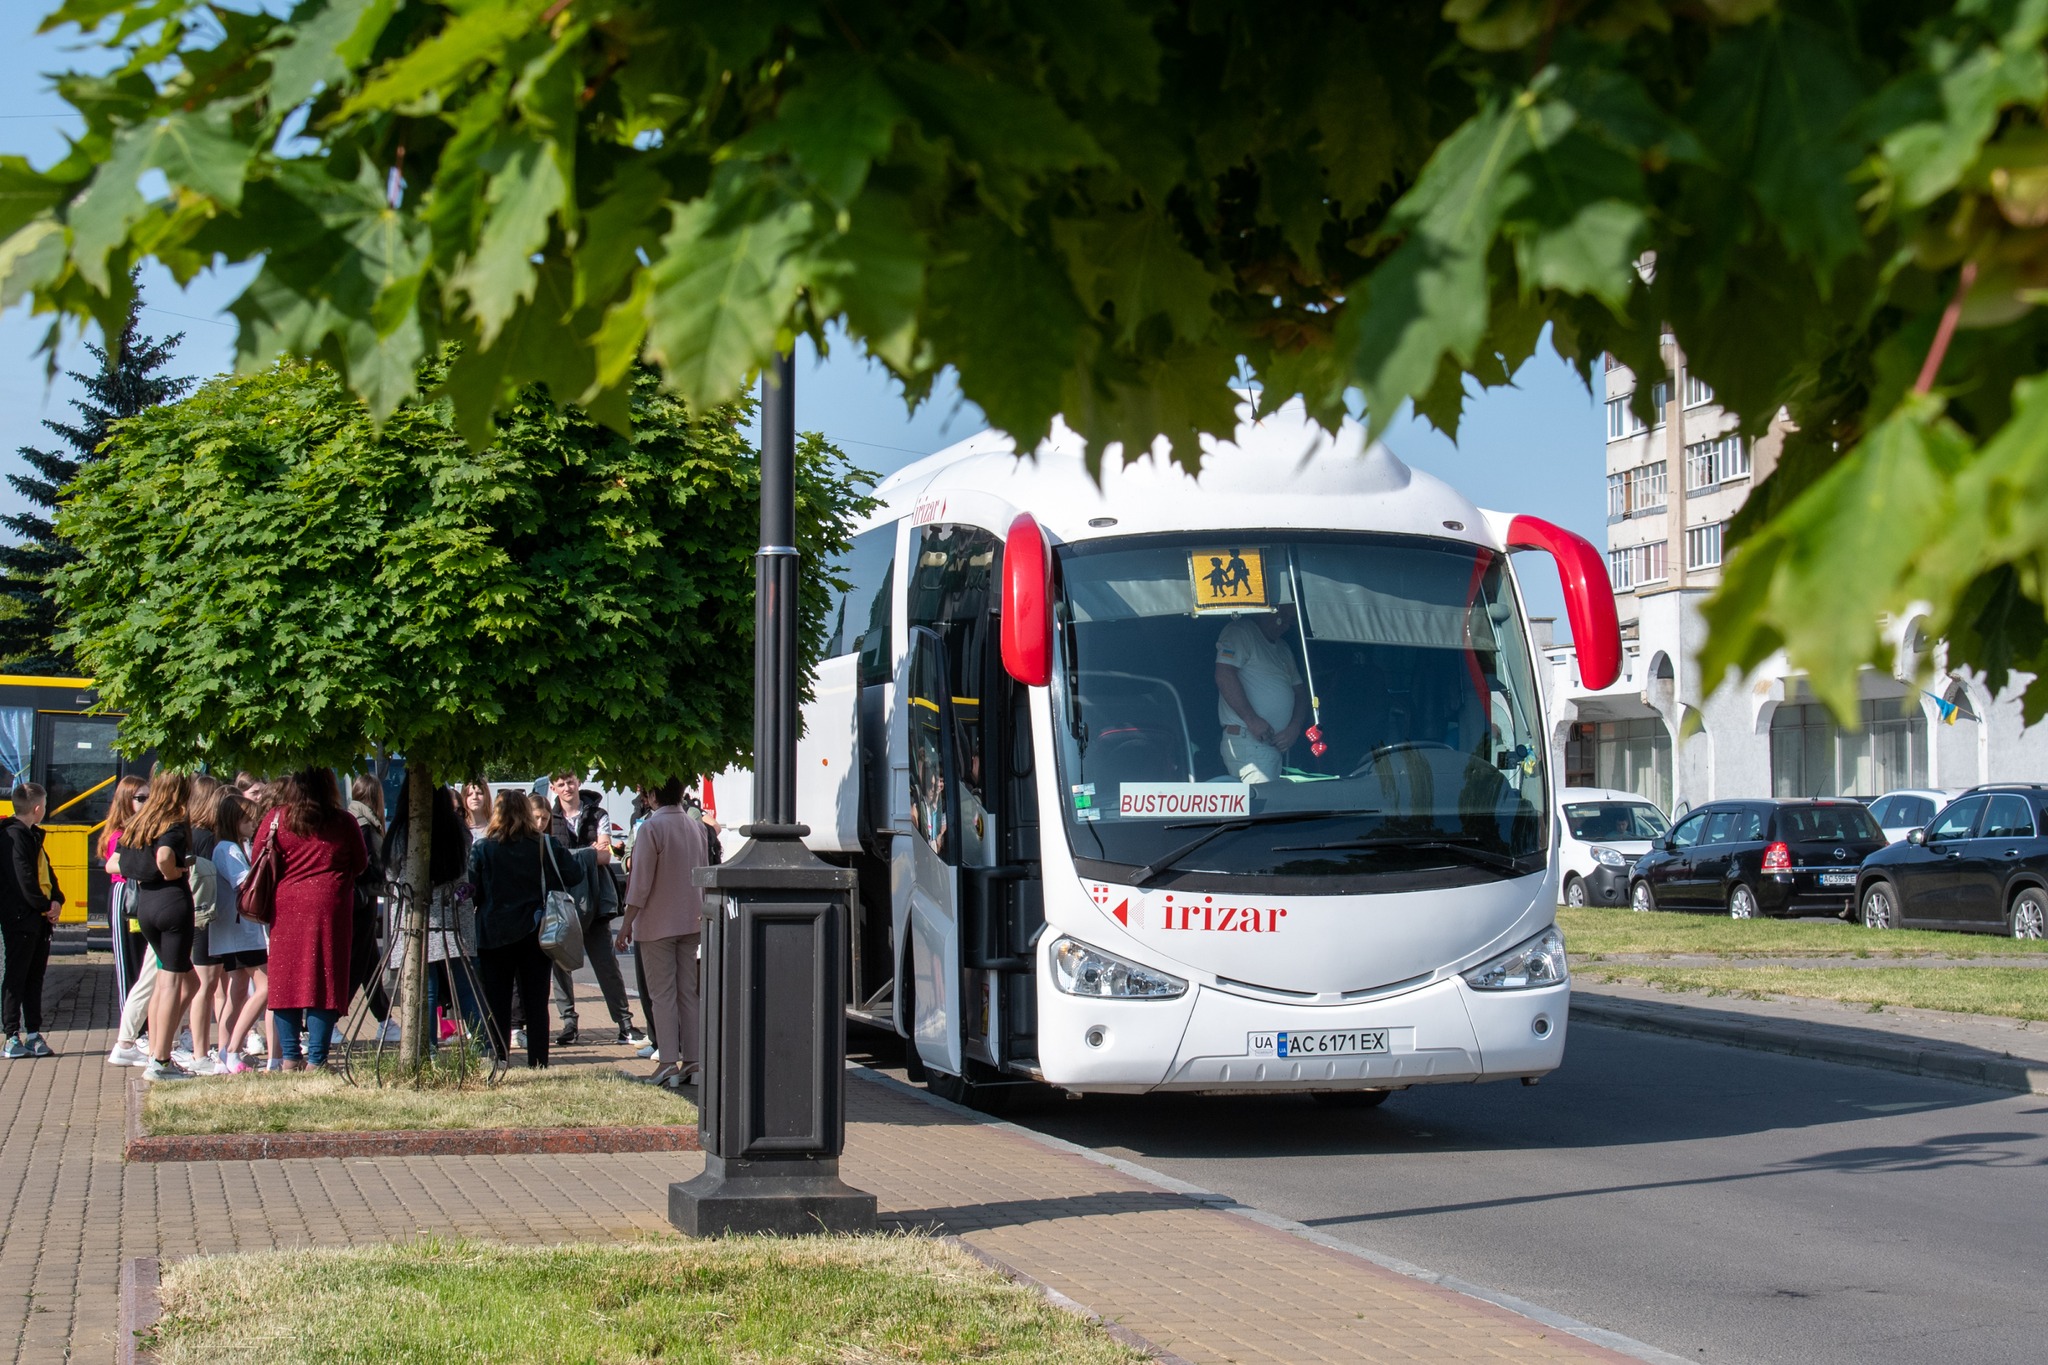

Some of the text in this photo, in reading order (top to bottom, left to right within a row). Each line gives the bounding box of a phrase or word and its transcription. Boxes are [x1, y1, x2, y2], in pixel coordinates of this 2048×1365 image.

[1120, 794, 1246, 813] BUSTOURISTIK
[1161, 895, 1288, 933] irizar
[1255, 1036, 1273, 1049] UA
[1289, 1032, 1385, 1053] AC 6171 EX
